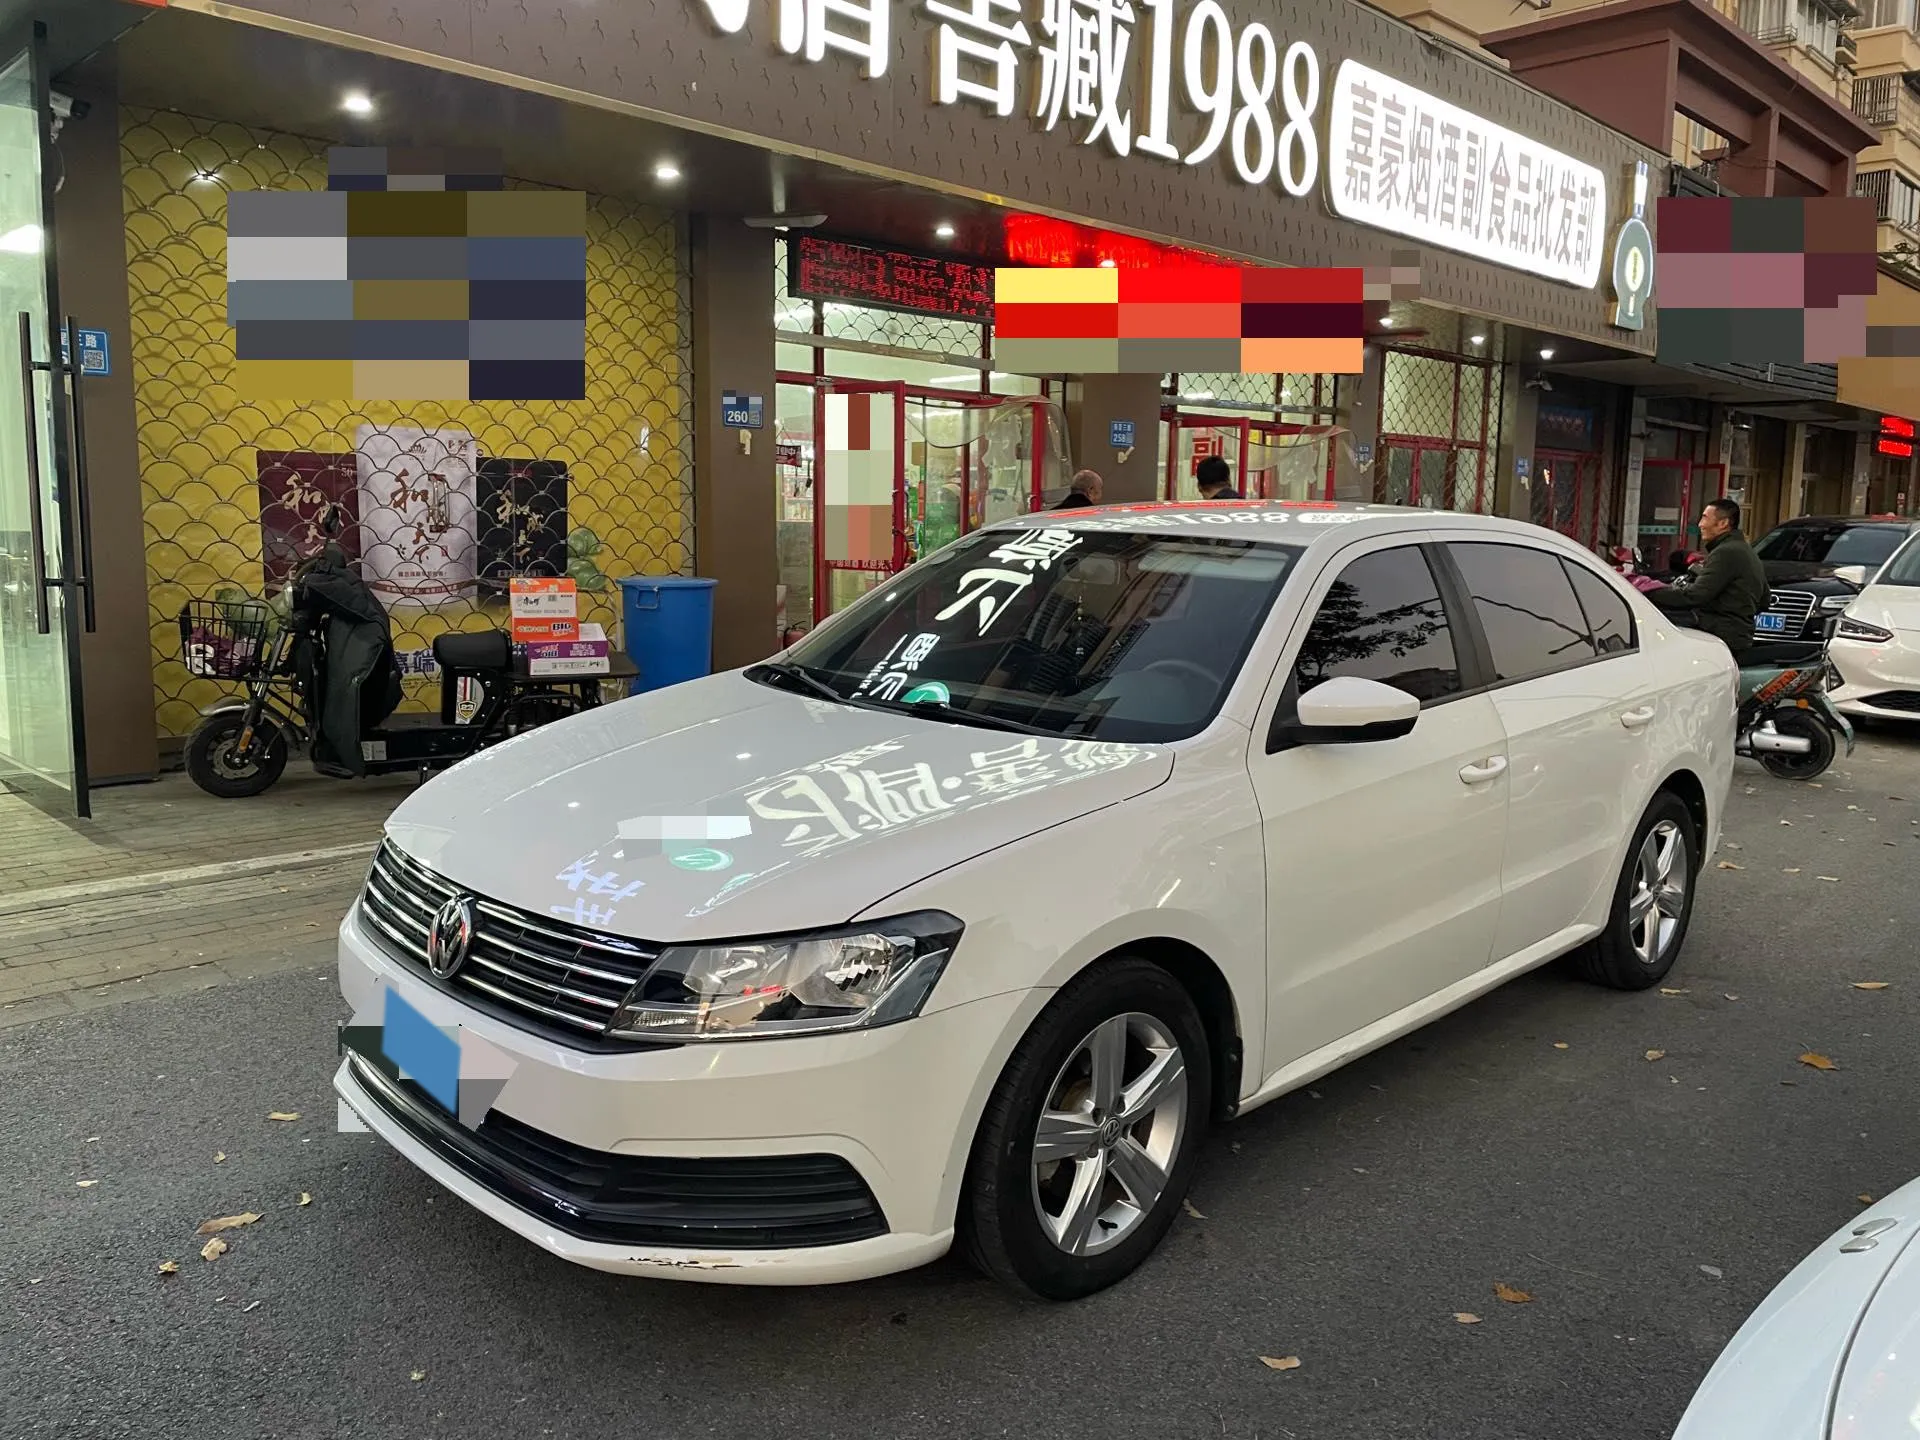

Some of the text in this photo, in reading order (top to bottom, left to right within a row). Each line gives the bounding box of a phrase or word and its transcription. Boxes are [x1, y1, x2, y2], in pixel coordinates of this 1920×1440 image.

[1345, 80, 1597, 274] 嘉豪烟酒副食品批发部
[727, 410, 748, 423] 260
